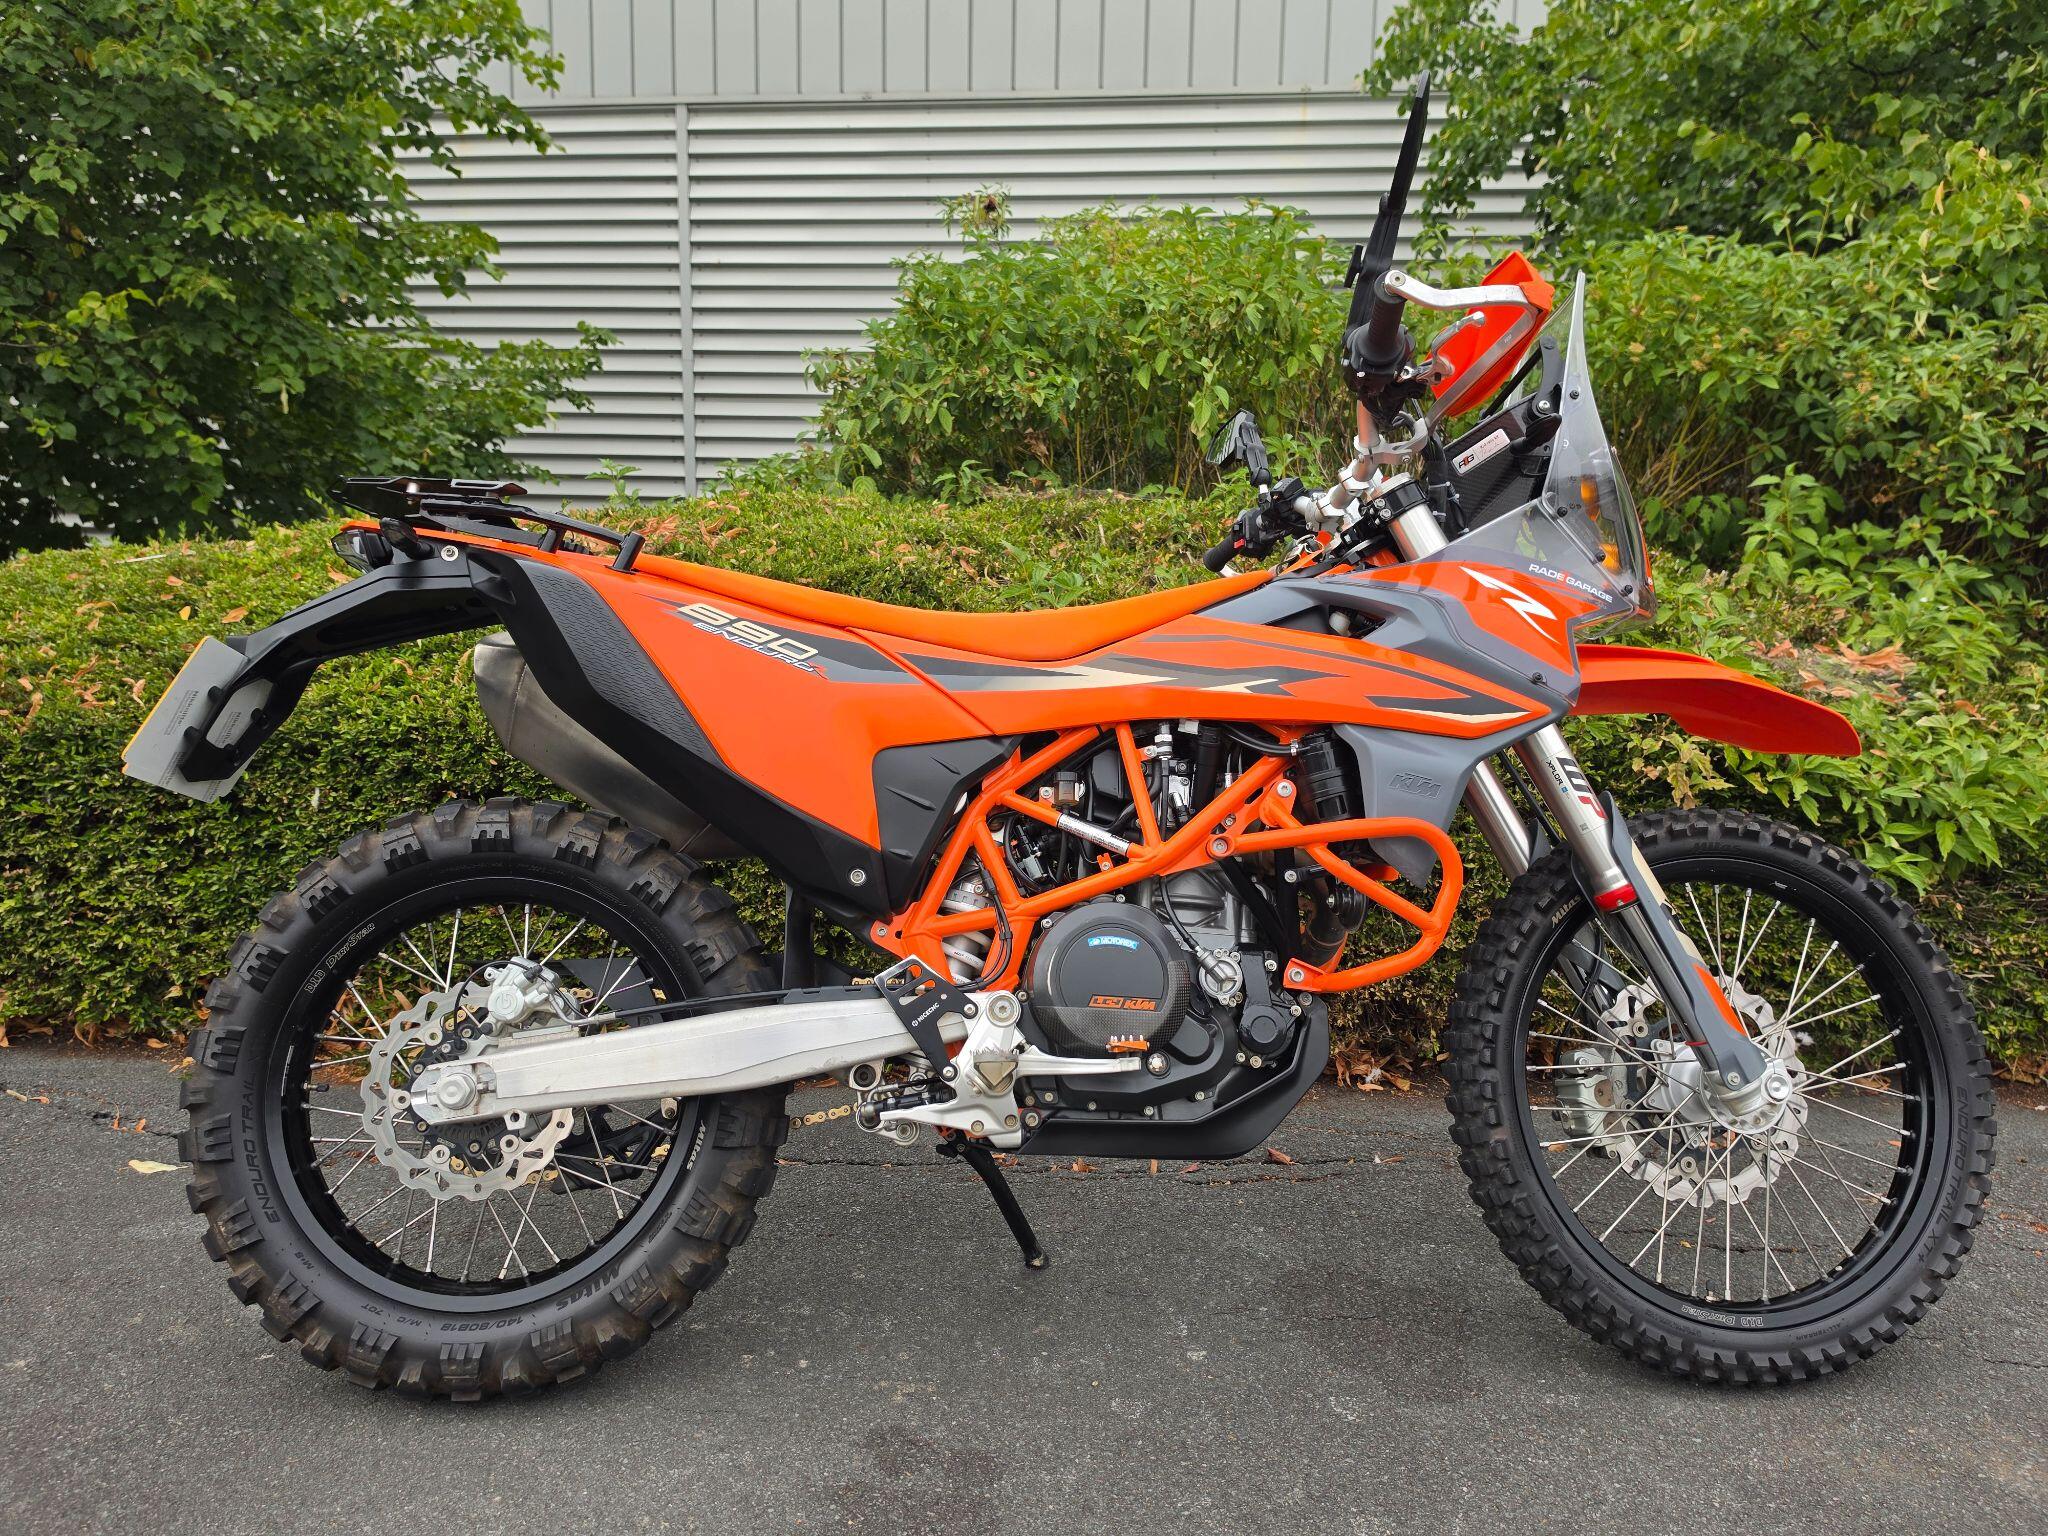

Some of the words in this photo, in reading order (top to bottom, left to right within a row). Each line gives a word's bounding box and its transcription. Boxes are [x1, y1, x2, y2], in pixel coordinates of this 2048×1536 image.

[1528, 563, 1565, 582] RADE
[1565, 577, 1613, 603] GARAGE
[677, 602, 819, 660] 690
[693, 622, 815, 672] ENDURO
[1389, 772, 1442, 799] KTM
[1546, 760, 1564, 785] XPLOR
[1552, 895, 1581, 928] Mitas
[1101, 936, 1137, 948] MOTOREX
[917, 1002, 940, 1022] NICECNC
[1123, 1000, 1156, 1010] KTM
[241, 1073, 256, 1136] TRAIL
[686, 1120, 706, 1171] Mitas
[1955, 1085, 1970, 1171] ENDURO
[243, 1139, 280, 1223] ENDURO
[1936, 1175, 1961, 1225] TRAIL
[555, 1261, 624, 1311] Mitas
[360, 1303, 384, 1316] 70T
[396, 1316, 423, 1327] M/C
